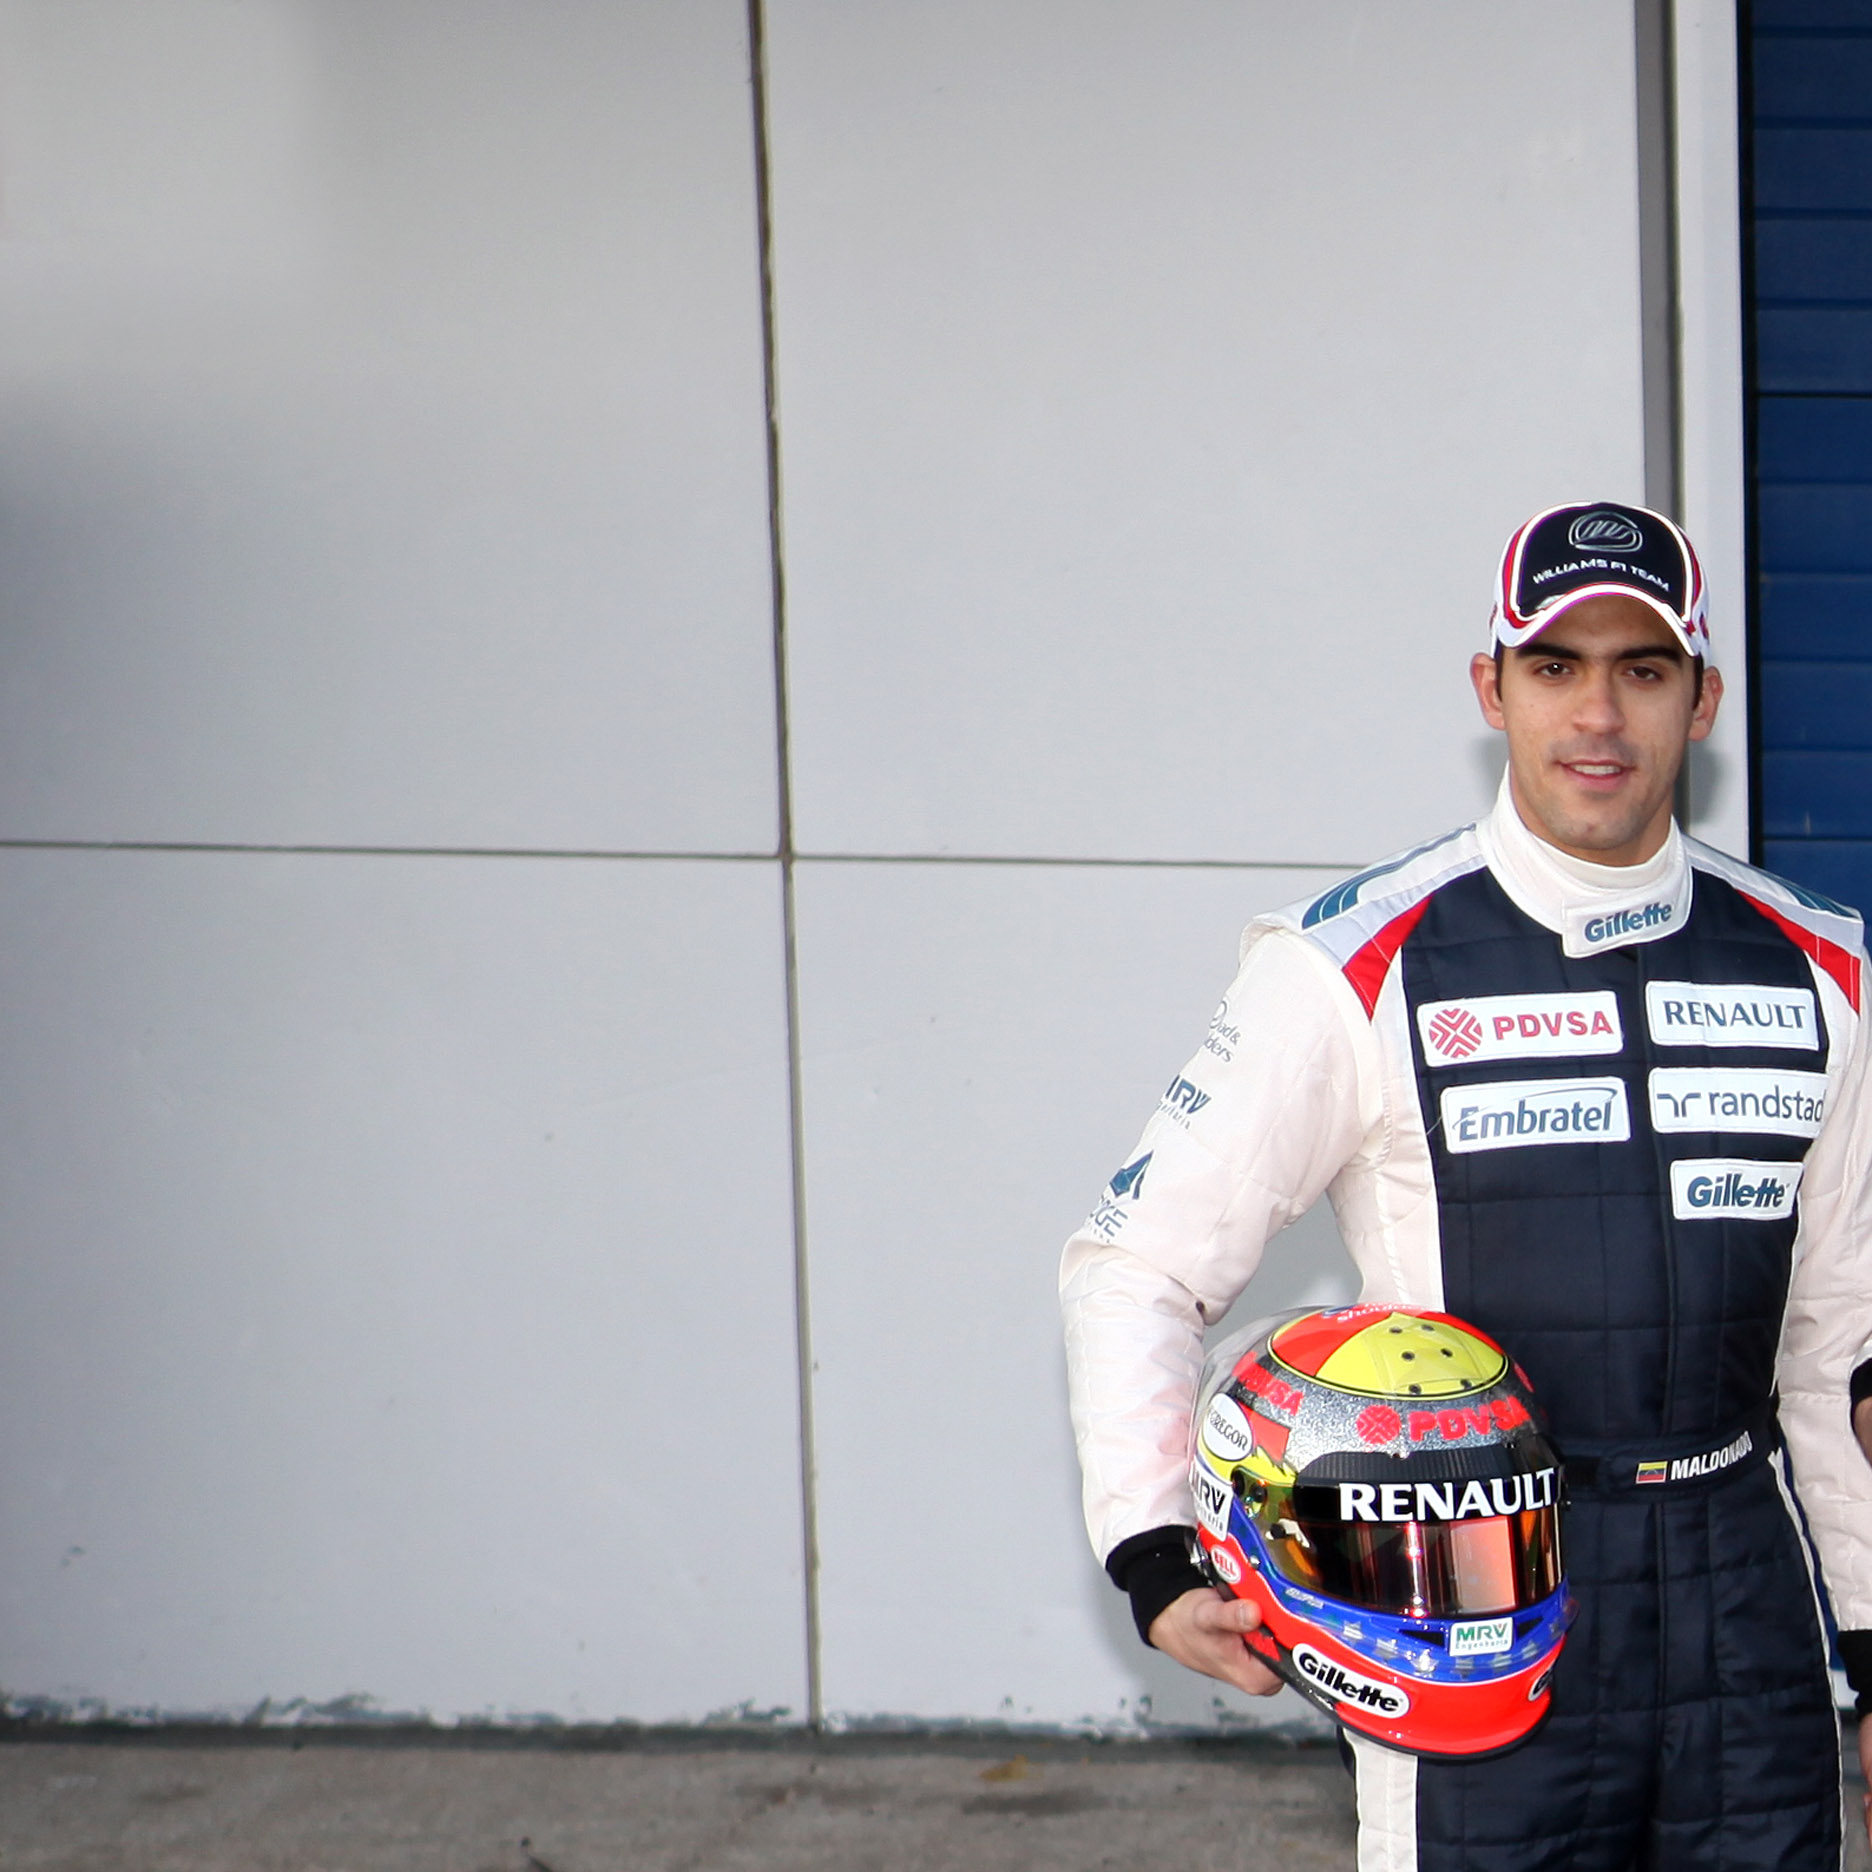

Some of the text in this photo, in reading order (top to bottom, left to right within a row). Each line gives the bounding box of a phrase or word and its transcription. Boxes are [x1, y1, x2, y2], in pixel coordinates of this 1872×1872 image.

[1533, 557, 1670, 592] WILLIAMS F1 TEAM
[1584, 902, 1672, 943] Gillette
[1492, 1000, 1806, 1041] PDVSA RENAULT
[1452, 1084, 1828, 1142] Embratel randstad
[1687, 1172, 1786, 1209] Gillette
[1408, 1394, 1532, 1442] PDVSA
[1339, 1467, 1556, 1523] RENAULT
[1456, 1622, 1508, 1642] MRV
[1298, 1651, 1400, 1713] Gillette
